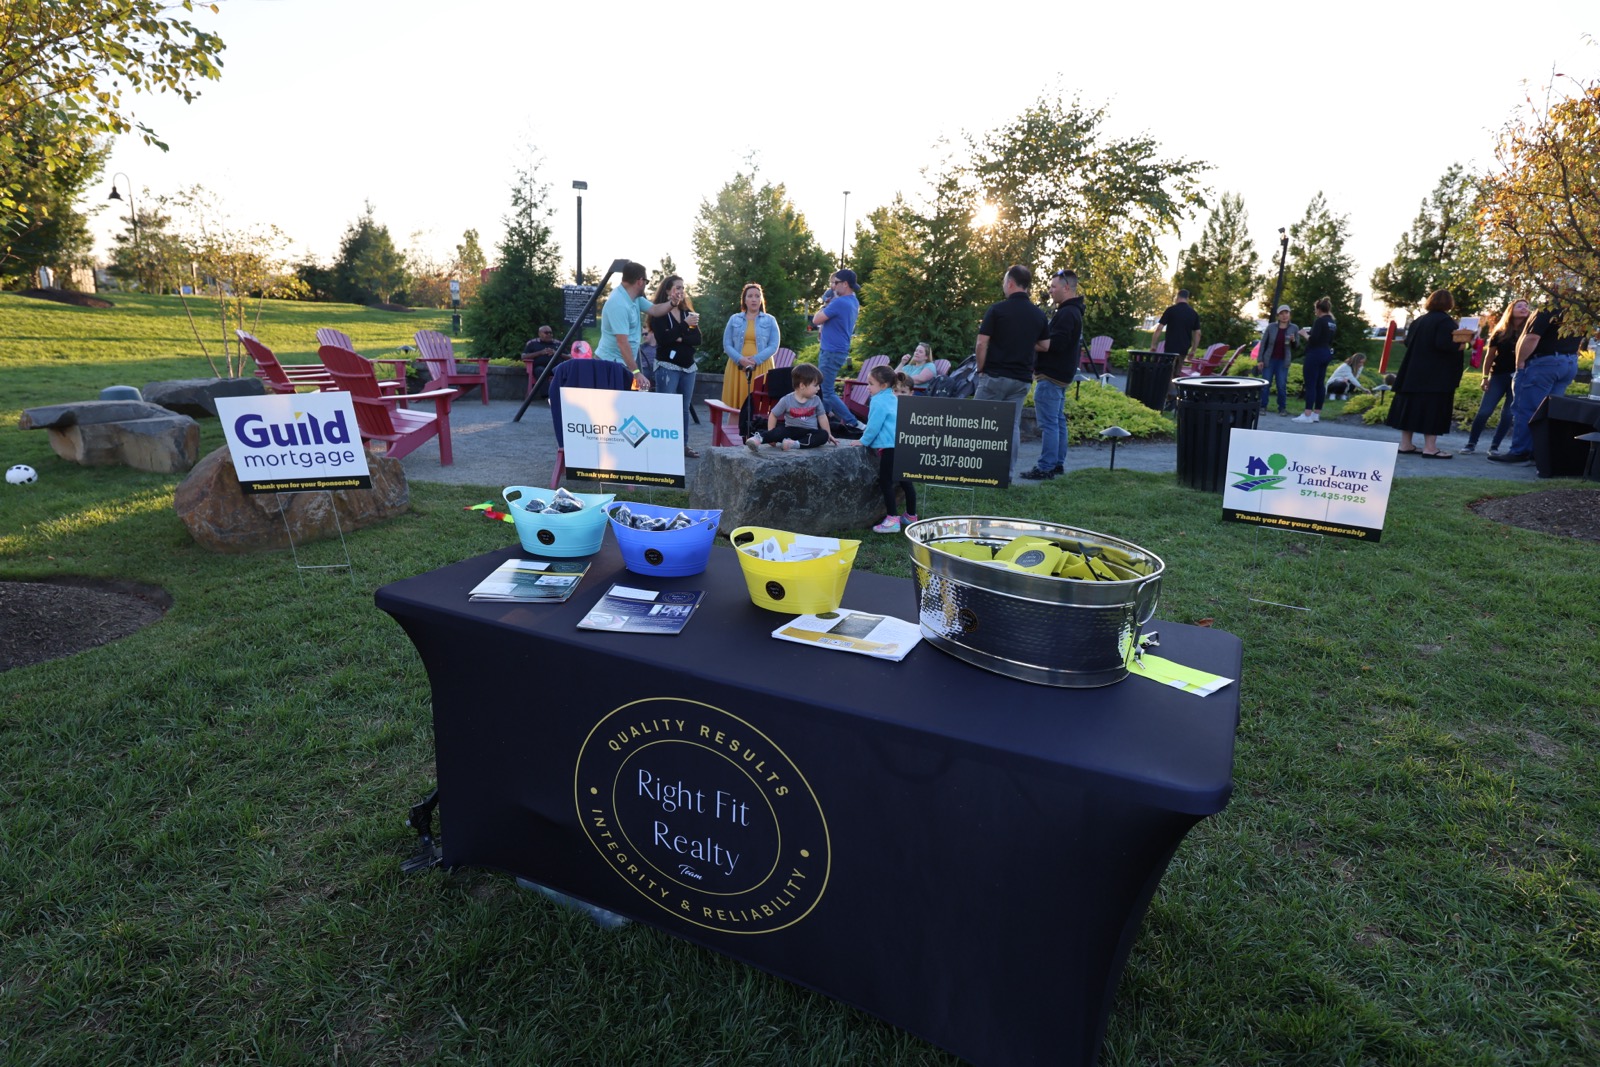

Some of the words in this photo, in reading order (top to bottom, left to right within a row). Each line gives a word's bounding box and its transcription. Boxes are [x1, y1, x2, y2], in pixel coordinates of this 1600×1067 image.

[234, 409, 350, 448] Guild
[910, 412, 944, 427] Accent
[946, 414, 979, 430] Homes
[568, 422, 618, 437] square
[651, 428, 679, 440] one
[898, 432, 942, 450] Property
[942, 434, 1008, 452] Management
[244, 450, 354, 468] mortgage
[920, 453, 982, 470] 703-317-8000
[636, 475, 674, 484] Sponsorship
[960, 476, 998, 486] Sponsorship
[1288, 461, 1327, 475] Jose's
[1330, 466, 1367, 480] Lawn
[1370, 470, 1383, 482] &
[317, 479, 360, 488] Sponsorship
[1297, 474, 1368, 494] Landscape
[1300, 489, 1366, 504] 571-435-1925
[1236, 512, 1262, 522] Thank
[1262, 516, 1278, 524] you
[1278, 518, 1290, 526] for
[1311, 523, 1366, 538] Sponsorship
[608, 719, 686, 752] QUALITY
[700, 724, 789, 796] RESULTS
[638, 768, 706, 814] Right
[716, 790, 750, 826] Fit
[654, 820, 740, 876] Realty
[592, 809, 670, 898] INTEGRITY
[680, 900, 691, 911] &
[702, 868, 806, 922] RELIABILITY
[678, 864, 703, 880] Team
